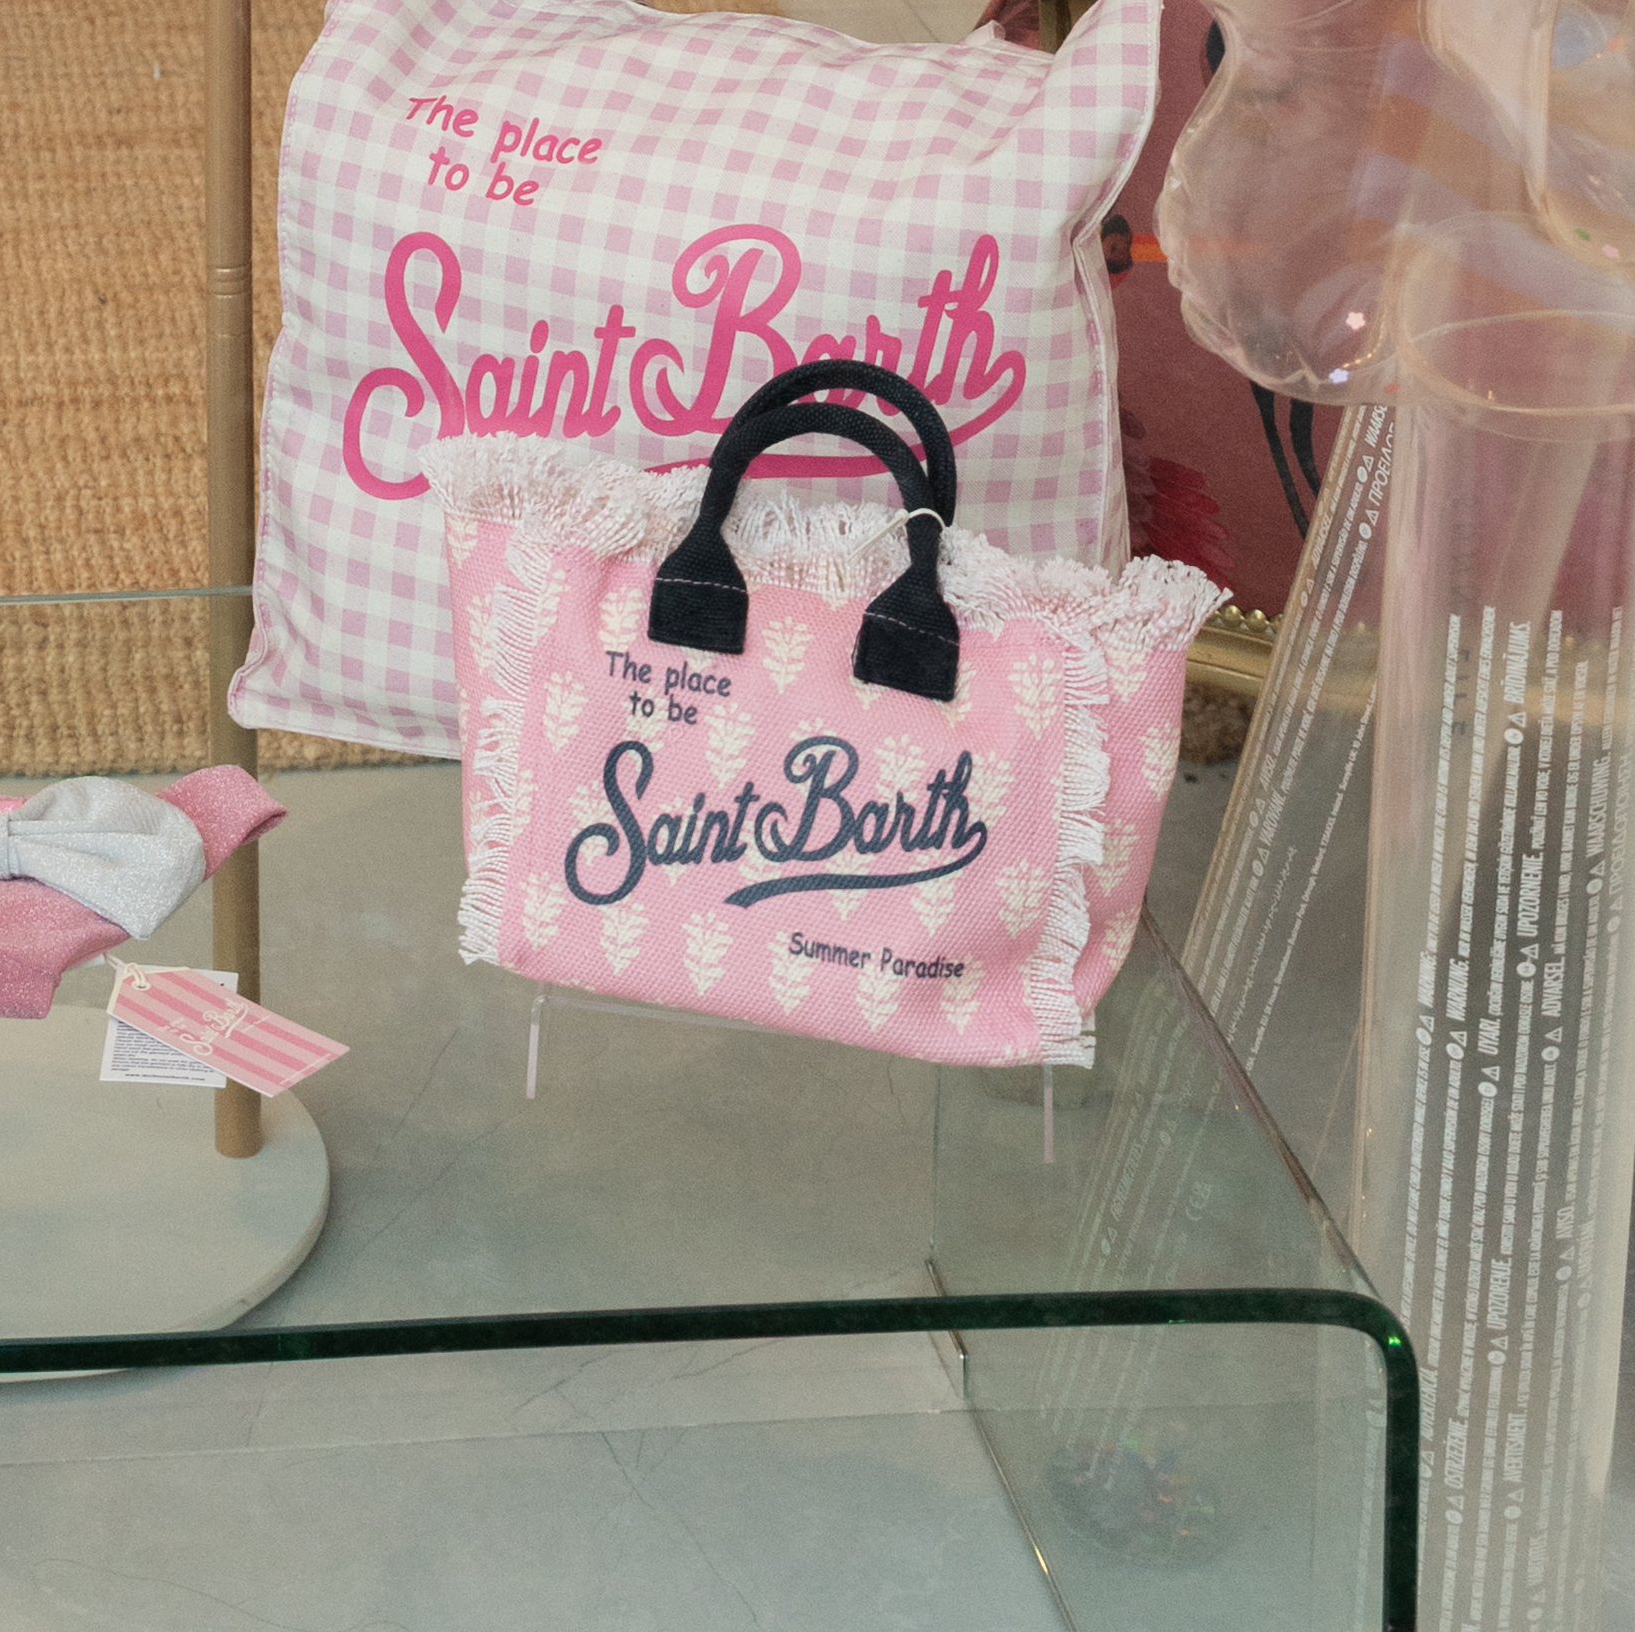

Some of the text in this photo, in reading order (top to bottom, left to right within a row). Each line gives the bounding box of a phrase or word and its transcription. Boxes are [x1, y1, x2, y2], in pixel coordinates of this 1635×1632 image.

[407, 95, 604, 166] The place
[428, 147, 539, 208] to be
[343, 223, 1026, 501] Saint Barth
[605, 650, 732, 699] The place
[629, 689, 698, 726] to be
[564, 735, 988, 906] Saint Barth
[1516, 851, 1544, 937] UPOZORNENIE.
[788, 931, 965, 981] Summer Paradise
[1540, 955, 1564, 1017] ADVARSEL.
[1445, 957, 1469, 1021] WARNUNG.
[1486, 1257, 1512, 1329] UPOZORENJE.
